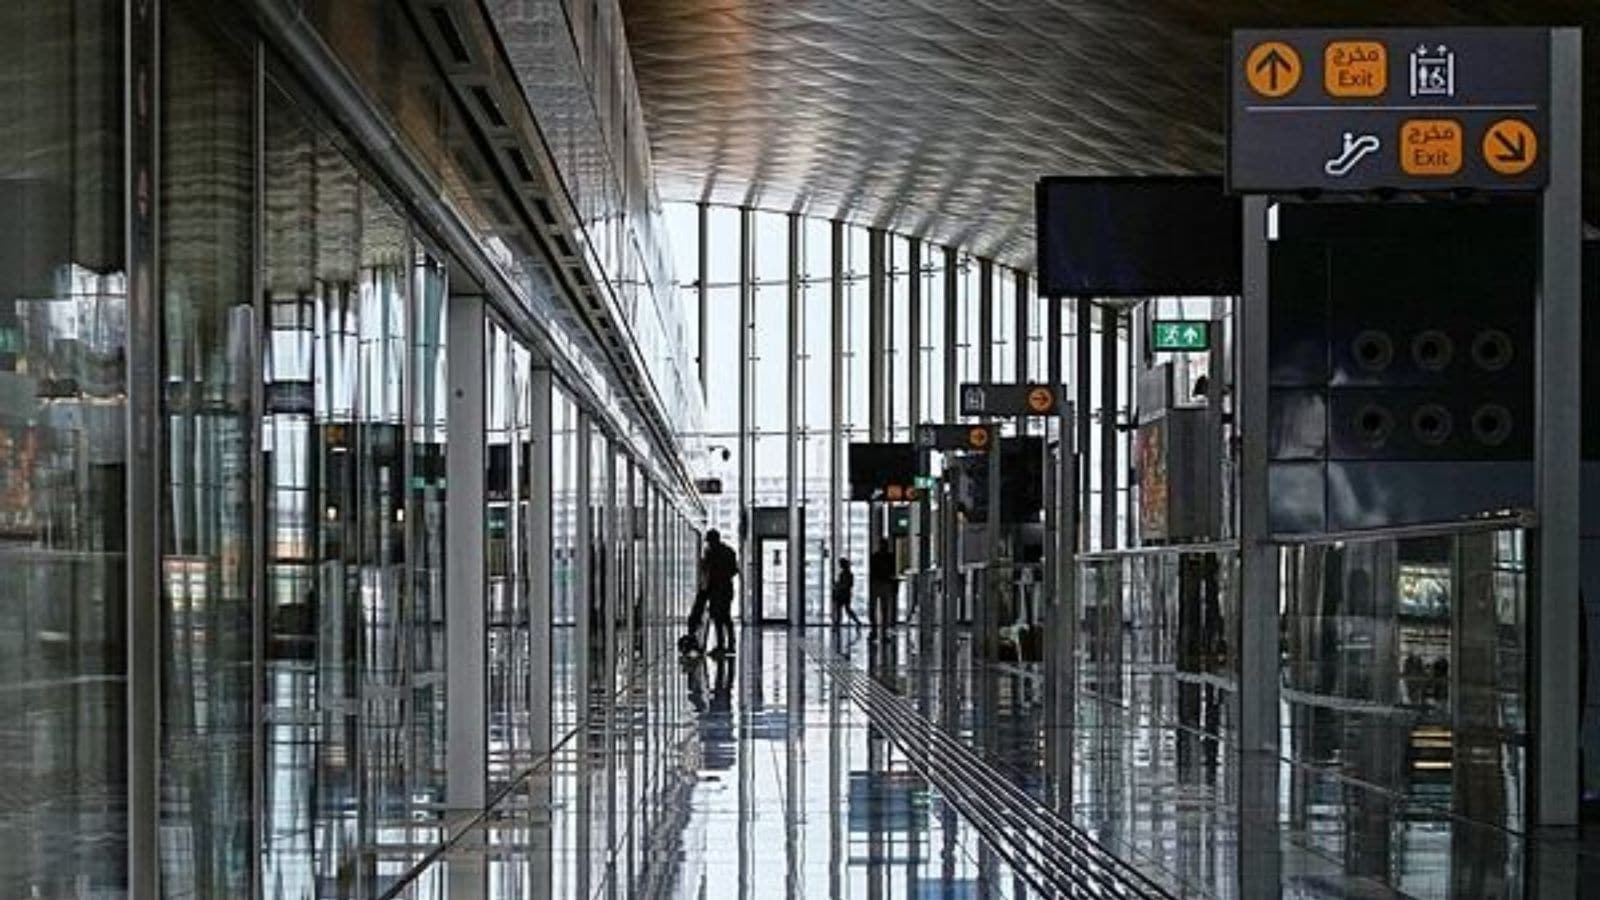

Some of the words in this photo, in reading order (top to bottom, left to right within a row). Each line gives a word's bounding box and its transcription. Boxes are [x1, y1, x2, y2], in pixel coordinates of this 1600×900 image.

[1333, 46, 1379, 66] مخرج
[1339, 69, 1373, 86] Exit
[1408, 125, 1454, 144] مخرج
[1415, 149, 1449, 166] Exit
